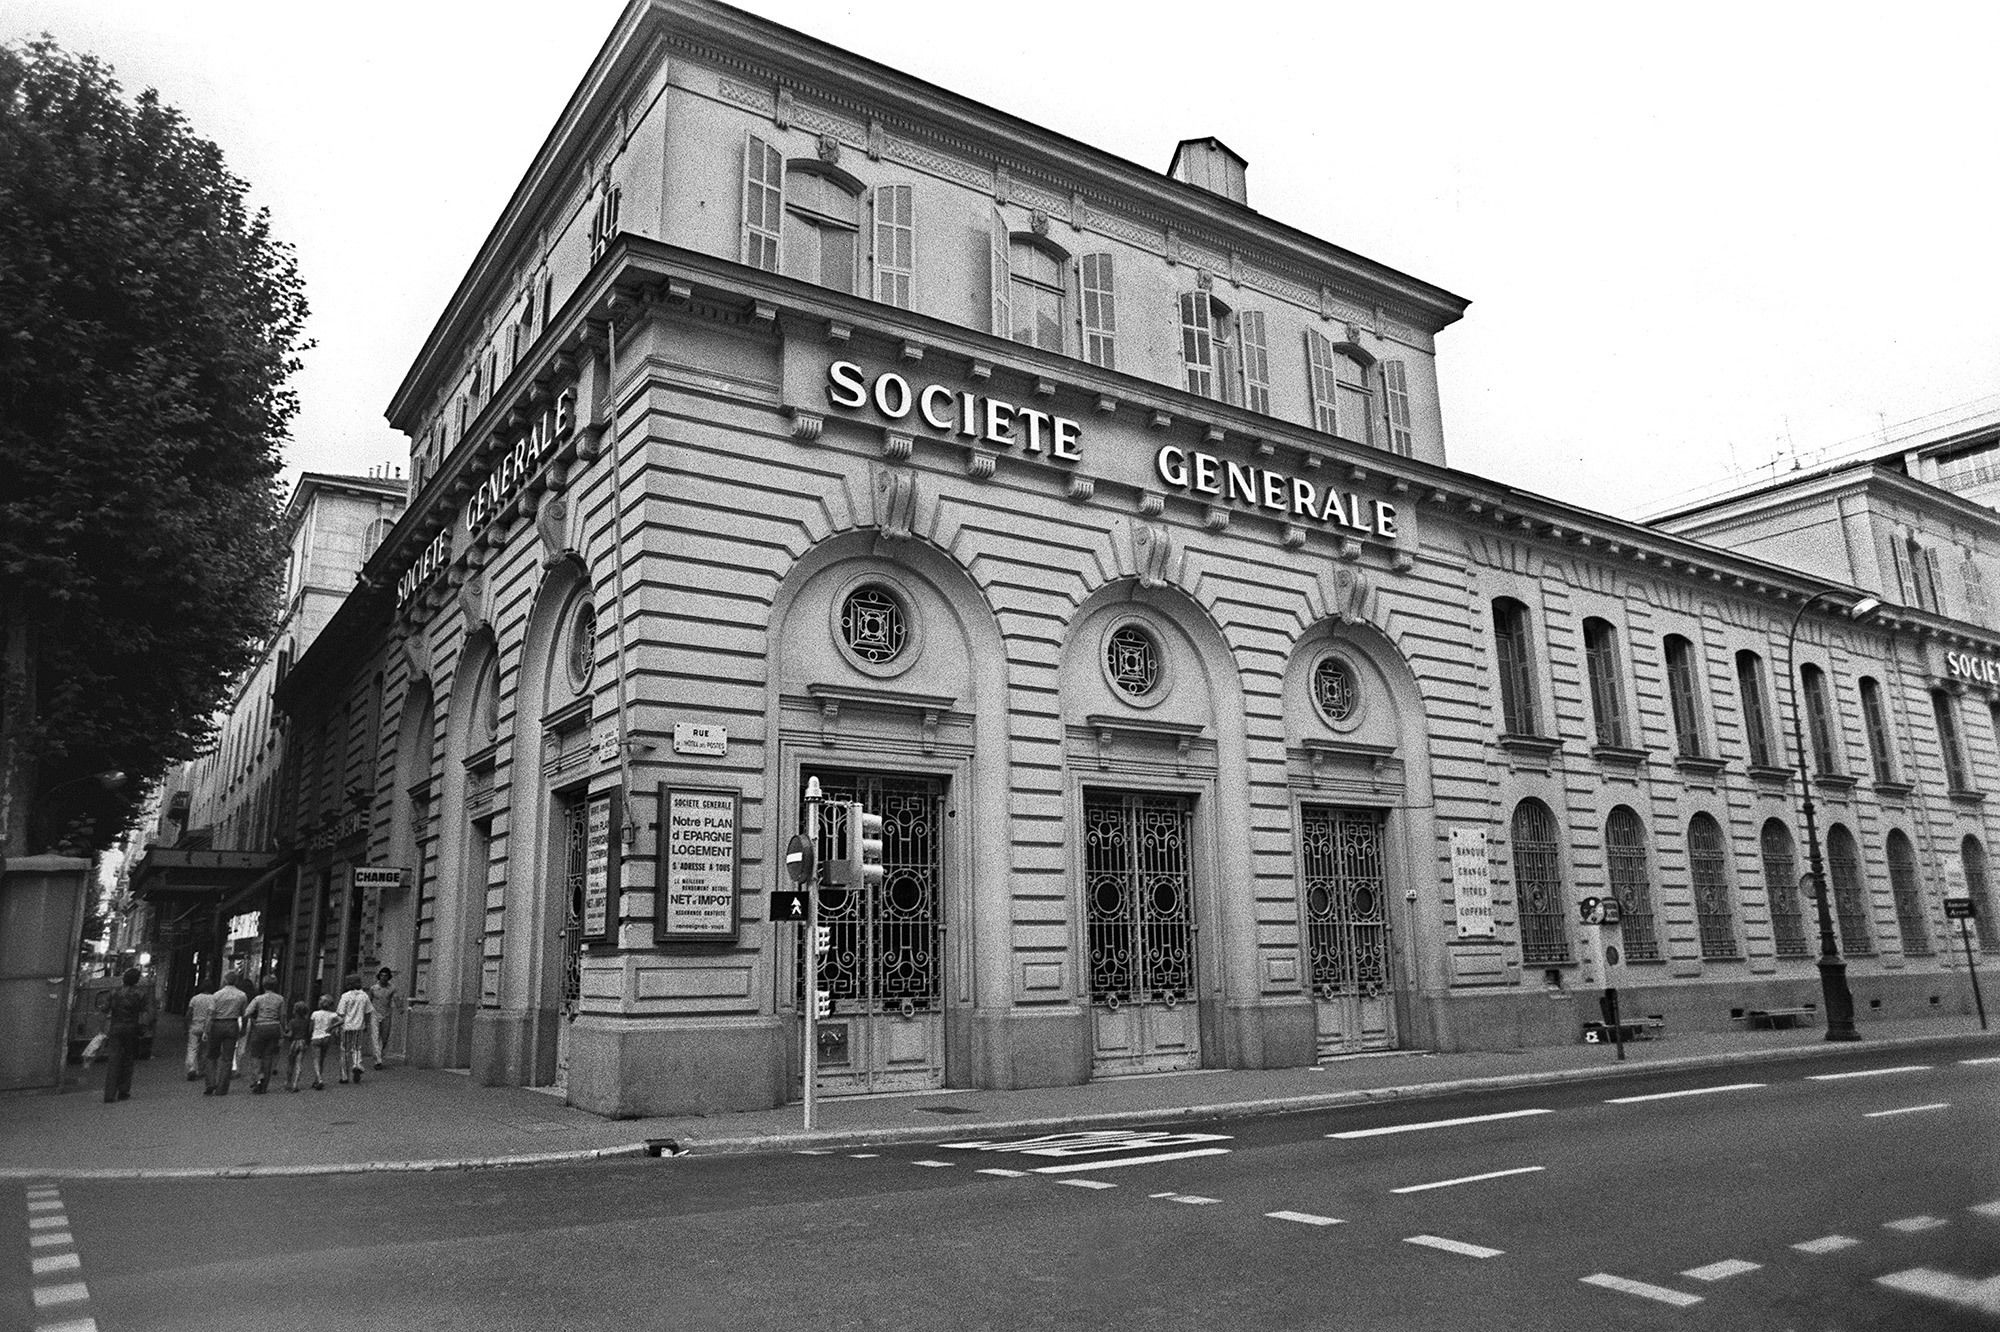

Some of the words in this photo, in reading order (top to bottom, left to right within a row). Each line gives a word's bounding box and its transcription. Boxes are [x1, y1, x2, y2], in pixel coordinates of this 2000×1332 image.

[827, 360, 1082, 461] SOCIETE
[1157, 445, 1397, 538] GENERALE
[396, 527, 450, 609] SOCIETE
[466, 387, 571, 532] GENERALE
[692, 729, 710, 738] RUE
[674, 798, 700, 809] SOCIETE
[702, 800, 732, 810] GENERALE
[672, 815, 701, 827] Notre
[704, 817, 733, 829] PLAN
[683, 830, 732, 843] EPARGNE
[671, 844, 733, 857] LOGEMENT
[1456, 846, 1486, 858] BANQUE
[715, 863, 731, 872] TOUS
[1458, 866, 1488, 877] CHANGE
[356, 872, 400, 883] CHANGE
[1462, 887, 1487, 897] TITRES
[670, 894, 692, 905] NET
